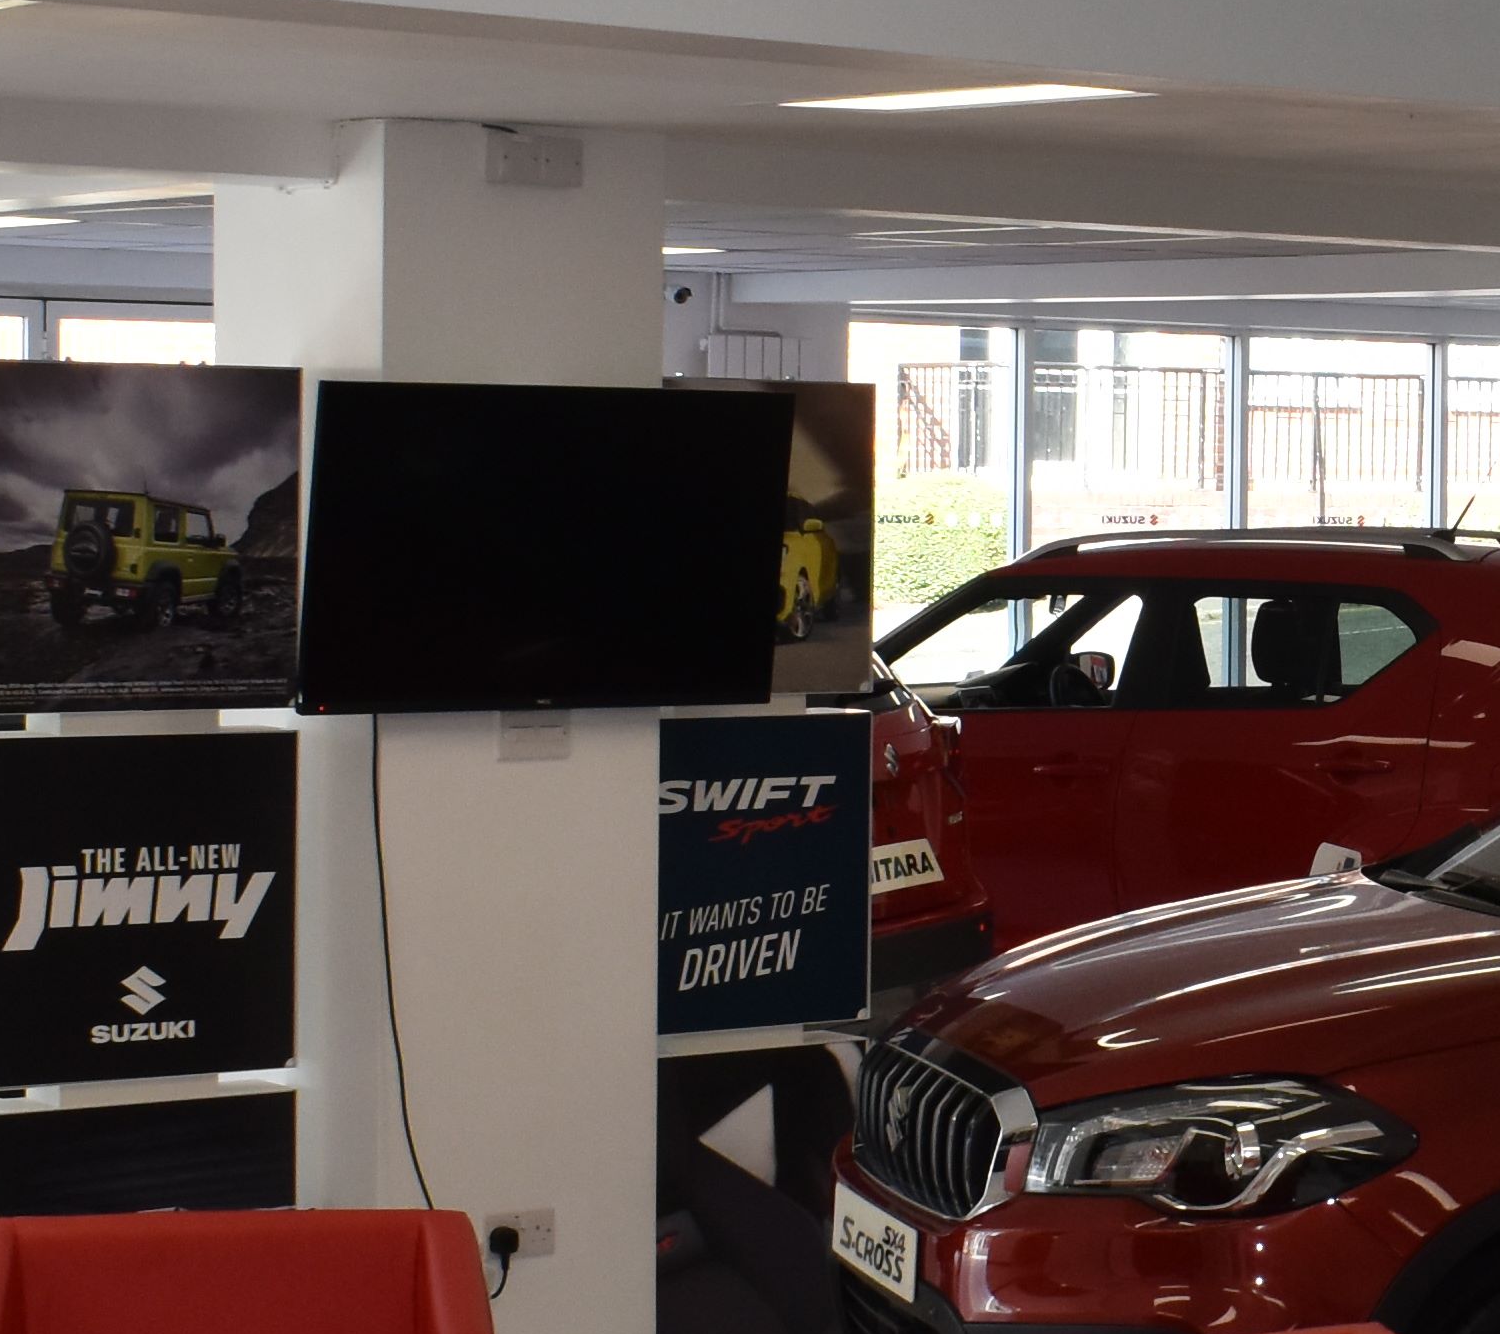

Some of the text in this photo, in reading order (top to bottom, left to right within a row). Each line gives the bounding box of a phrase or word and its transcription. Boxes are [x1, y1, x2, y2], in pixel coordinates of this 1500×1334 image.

[658, 775, 837, 815] SWIFT
[81, 843, 241, 874] THE ALL-NEW
[870, 851, 935, 883] ITARA
[2, 865, 276, 952] Jimny
[660, 883, 831, 941] IT WANTS TO BE
[678, 927, 802, 992] DRIVEN
[90, 1019, 196, 1044] SUZUKI
[882, 1225, 906, 1254] SX4
